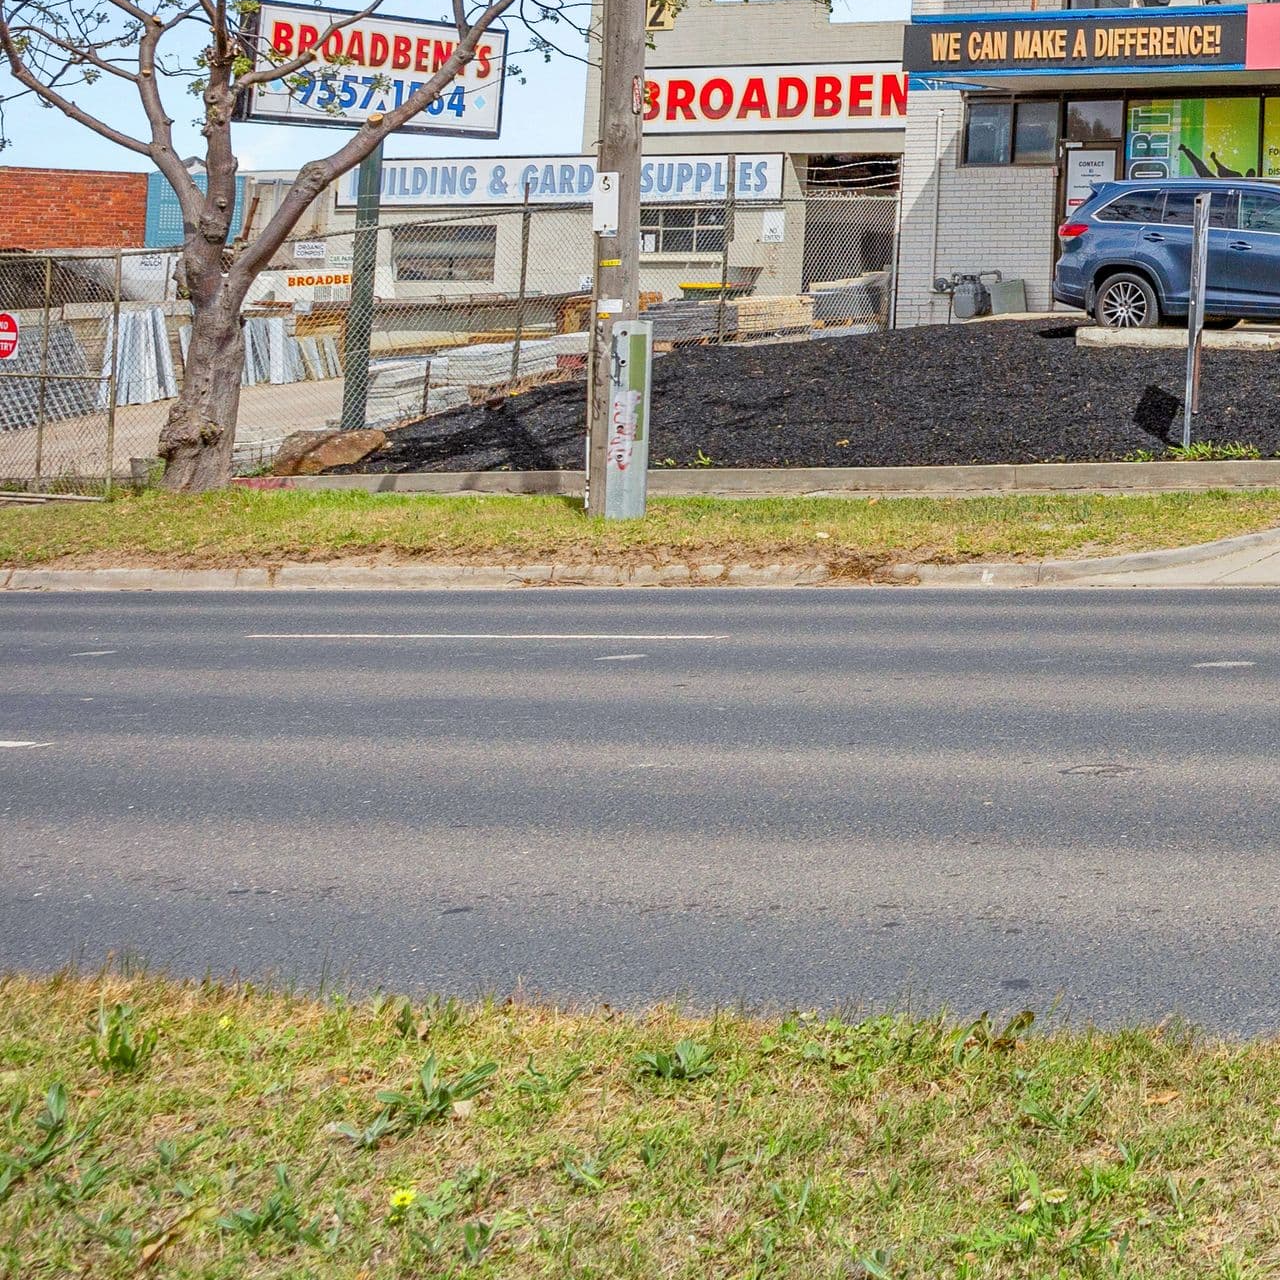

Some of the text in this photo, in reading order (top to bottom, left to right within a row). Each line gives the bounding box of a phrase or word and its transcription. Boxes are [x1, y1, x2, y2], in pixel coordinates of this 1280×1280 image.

[931, 25, 1222, 61] WE CAN MAKE A DIFFERENCE!
[352, 160, 769, 197] ILDING & GARD SUPPLES
[288, 274, 353, 287] BROADBE
